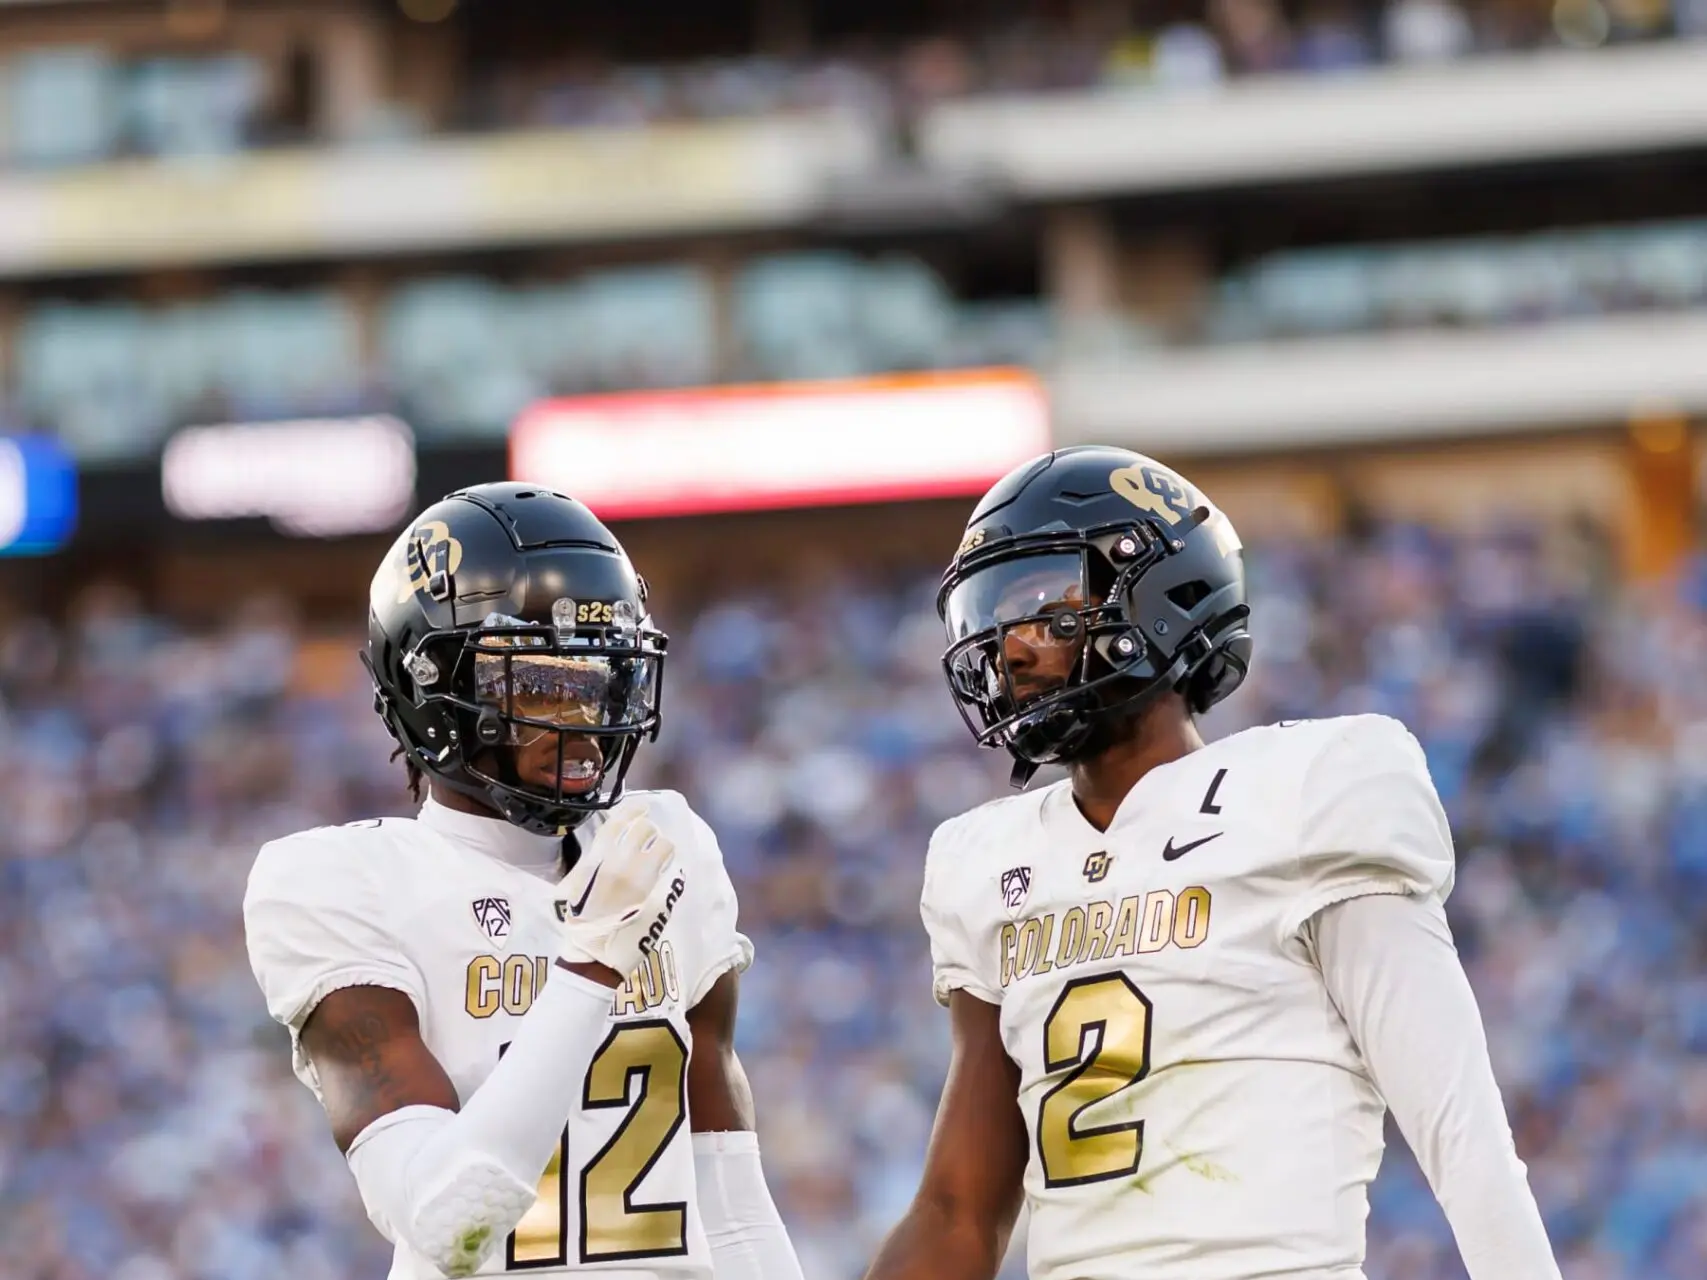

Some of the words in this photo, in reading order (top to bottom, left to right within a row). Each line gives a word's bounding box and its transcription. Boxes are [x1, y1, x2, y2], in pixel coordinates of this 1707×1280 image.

[1199, 769, 1228, 815] L
[1001, 866, 1031, 899] PAC
[1083, 851, 1112, 882] CU
[472, 897, 511, 927] PAC
[1006, 888, 1021, 908] 12
[487, 918, 508, 938] 12
[1000, 886, 1212, 988] COLORADO
[465, 941, 679, 1019] COADO
[1038, 970, 1153, 1188] 2
